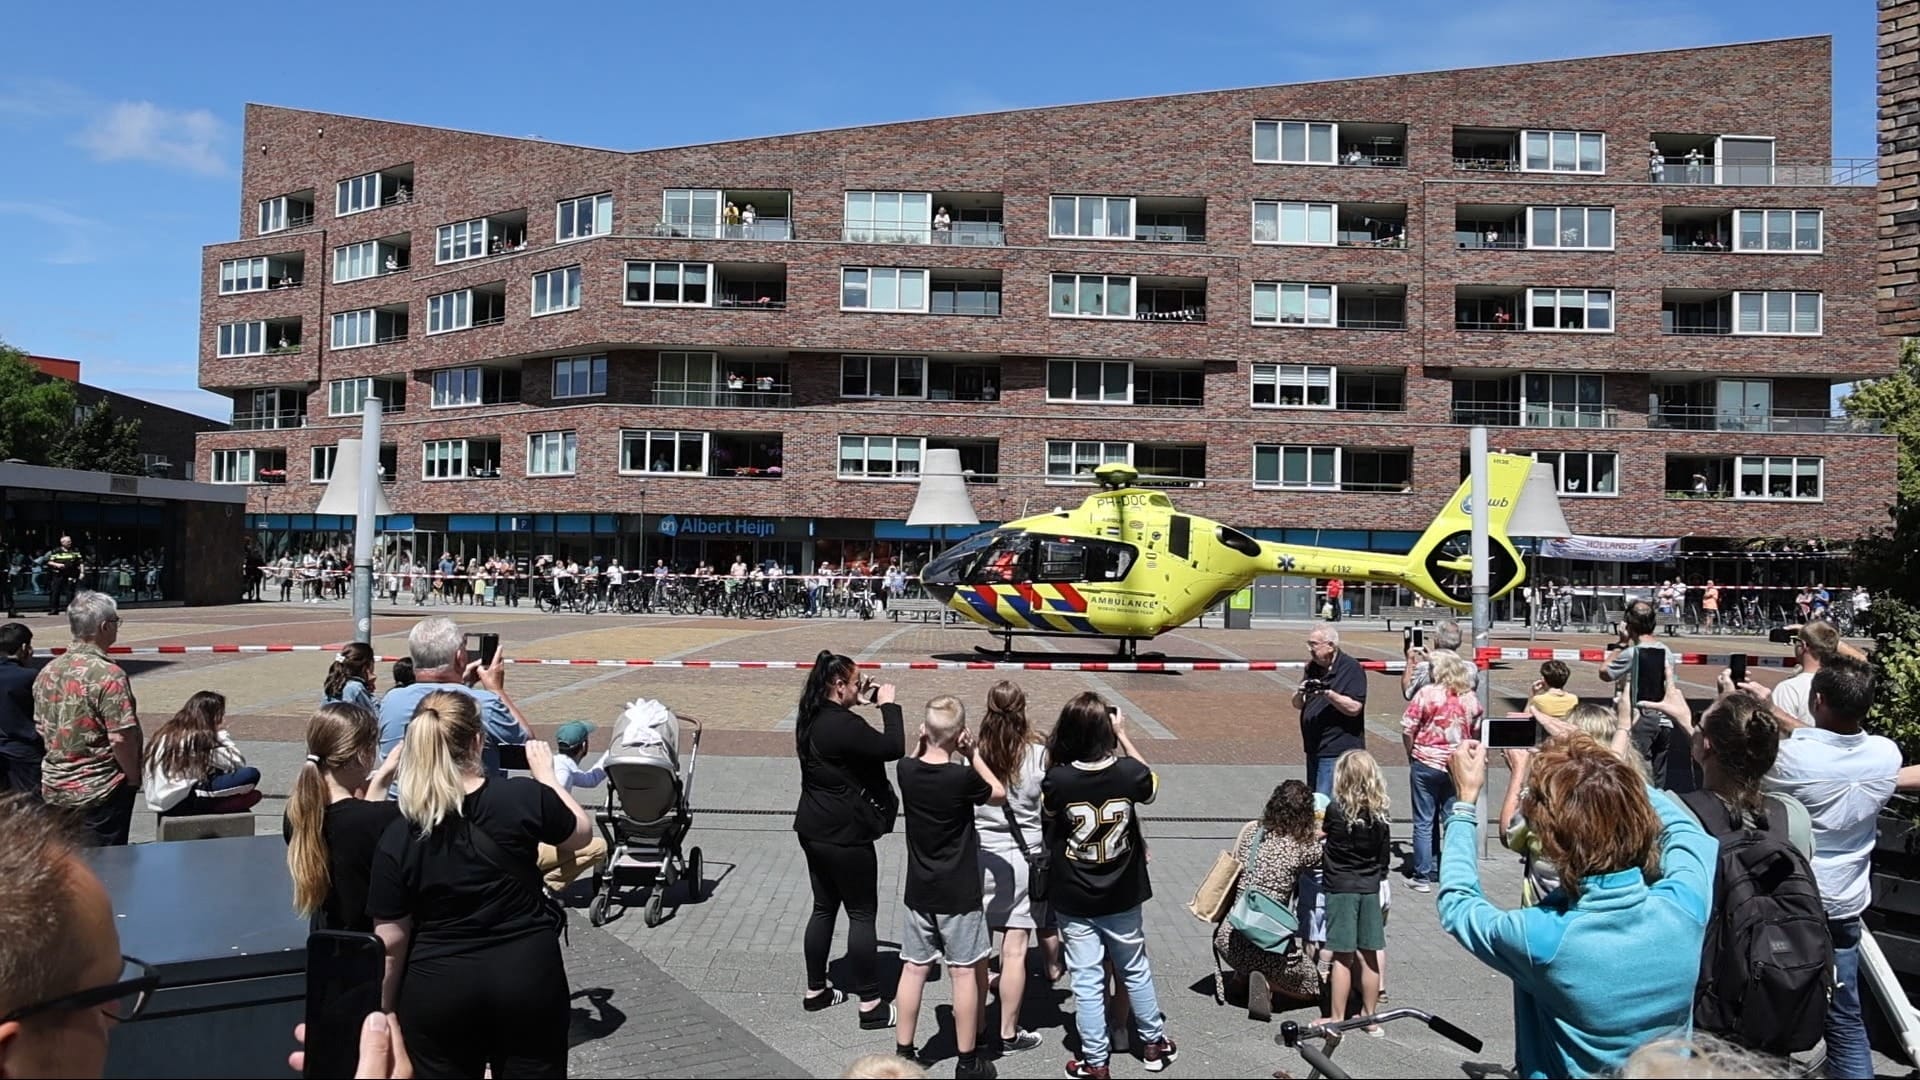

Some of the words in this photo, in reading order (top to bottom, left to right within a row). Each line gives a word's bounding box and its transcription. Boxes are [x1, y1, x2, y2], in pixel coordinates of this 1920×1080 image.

[1097, 494, 1147, 508] PH-DOC
[681, 518, 732, 533] Albert
[735, 519, 775, 537] Heijn
[1090, 596, 1155, 609] AMBULANCE
[1065, 798, 1131, 863] 22
